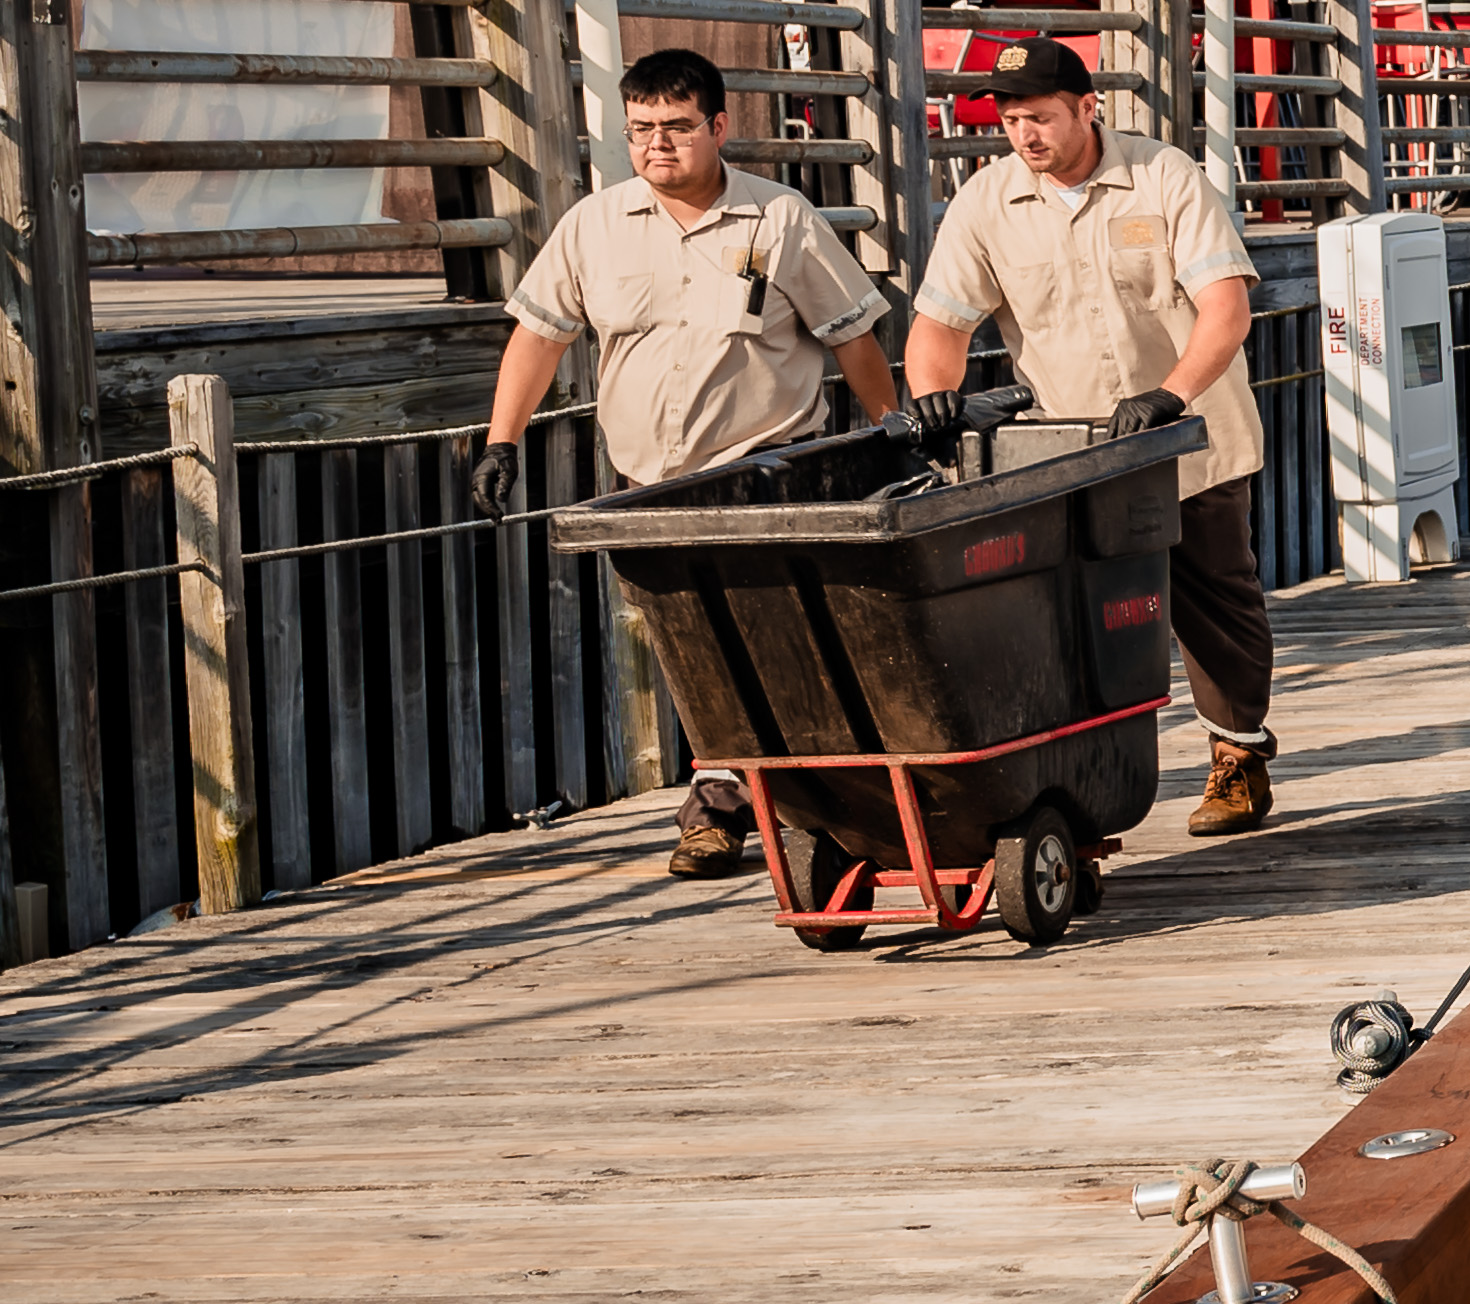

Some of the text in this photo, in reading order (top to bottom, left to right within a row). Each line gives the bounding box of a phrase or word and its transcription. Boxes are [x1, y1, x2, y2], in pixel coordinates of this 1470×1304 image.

[1328, 307, 1347, 354] FIRE
[1359, 297, 1370, 366] DEPARTMENT
[1371, 298, 1382, 365] CONNECTION
